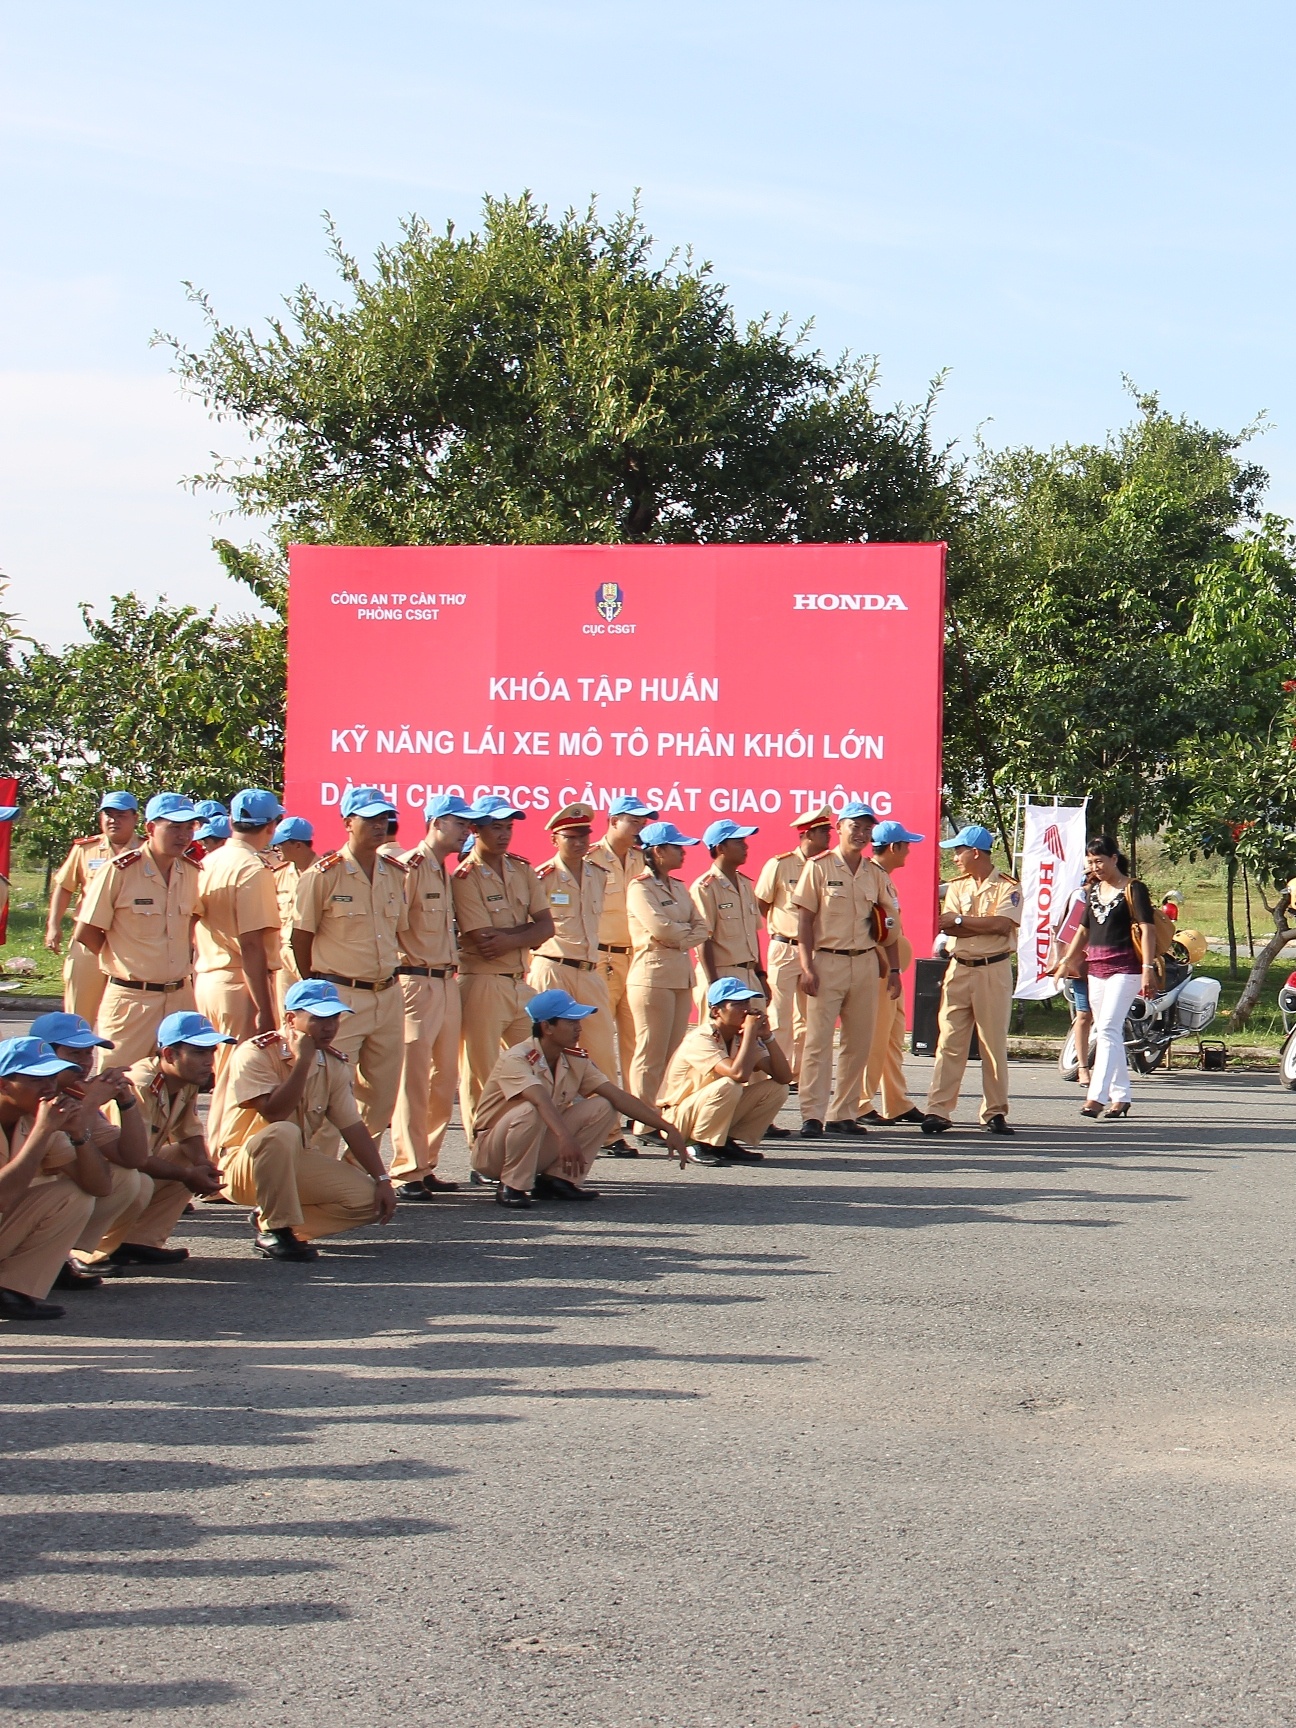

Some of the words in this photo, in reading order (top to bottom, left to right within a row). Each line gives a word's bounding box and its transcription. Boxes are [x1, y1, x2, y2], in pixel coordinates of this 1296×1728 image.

[331, 590, 367, 604] CÔNG
[370, 594, 388, 604] AN
[391, 594, 407, 604] TP
[439, 594, 466, 605] THƠ
[793, 594, 908, 610] HONDA
[358, 606, 402, 620] PHÒNG
[405, 609, 439, 620] CSGT
[582, 624, 605, 636] CỤC
[608, 624, 636, 634] CSGT
[489, 671, 571, 701] KHÓA
[577, 674, 633, 708] TẬP
[640, 672, 719, 702] HUẤN
[331, 724, 369, 752] KỸ
[376, 724, 454, 754] NĂNG
[463, 724, 505, 755] LÁI
[512, 731, 550, 755] XE
[558, 726, 603, 756] MÔ
[610, 726, 649, 756] TÔ
[657, 726, 735, 757] PHÂN
[744, 728, 814, 758] KHỐI
[823, 728, 884, 759] LỚN
[321, 776, 398, 807] DH
[646, 781, 702, 812] SÁT
[709, 788, 782, 813] GIAO
[1036, 861, 1055, 983] HONDA
